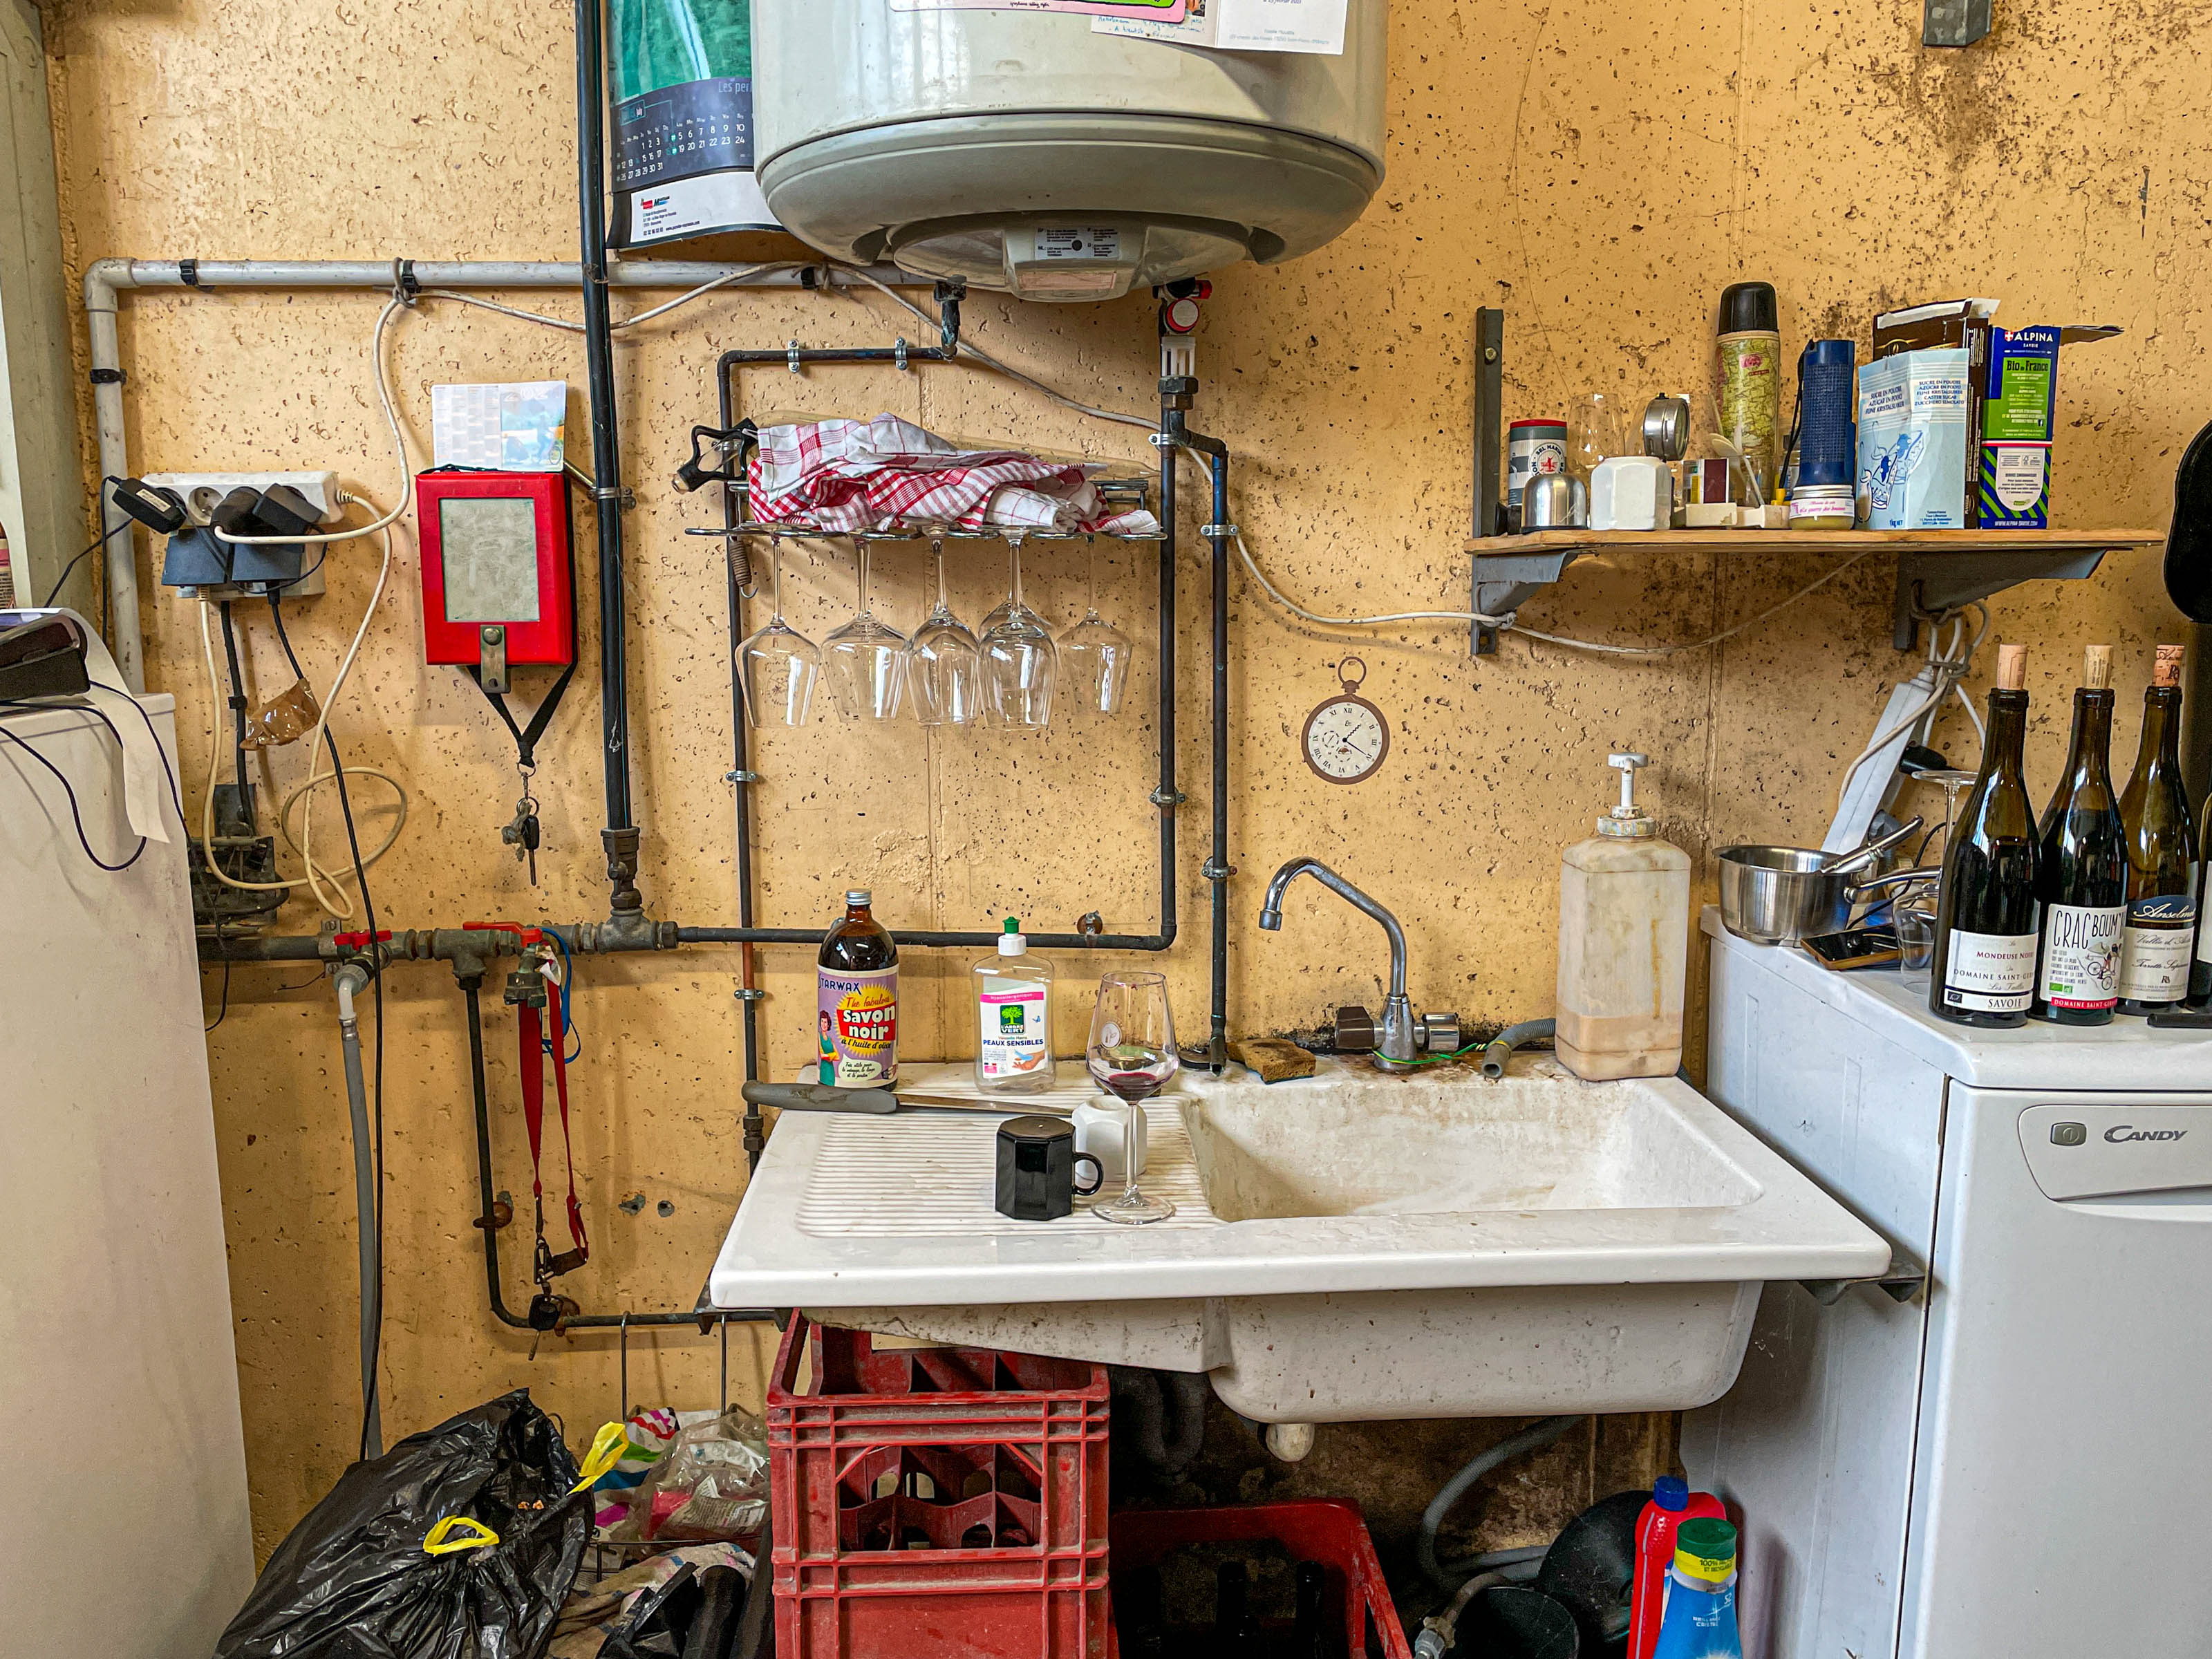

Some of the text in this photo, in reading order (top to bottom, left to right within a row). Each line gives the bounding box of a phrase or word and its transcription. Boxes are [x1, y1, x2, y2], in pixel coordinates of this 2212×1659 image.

[718, 82, 732, 93] Les
[688, 130, 693, 138] 6
[648, 140, 653, 148] 2
[656, 137, 660, 146] 3
[678, 144, 684, 153] 19
[687, 142, 695, 151] 20
[699, 140, 705, 149] 21
[709, 138, 718, 147] 22
[721, 136, 731, 144] 23
[649, 164, 655, 173] 30
[657, 162, 664, 170] 31
[2014, 332, 2053, 342] ALPINA
[2007, 360, 2020, 371] Bio
[2025, 361, 2048, 371] France
[1536, 447, 1546, 455] SEL
[2054, 910, 2091, 950] CRAC
[1977, 951, 2017, 959] MONDEUSE
[1954, 969, 1994, 980] DOMAINE
[818, 973, 861, 995] STARWAX
[846, 997, 860, 1008] The
[1988, 999, 2022, 1008] SAVOIE
[2054, 999, 2084, 1008] DOMAINE
[849, 1024, 889, 1040] noir
[848, 1038, 872, 1049] l'huile
[2104, 1125, 2188, 1143] CANDY
